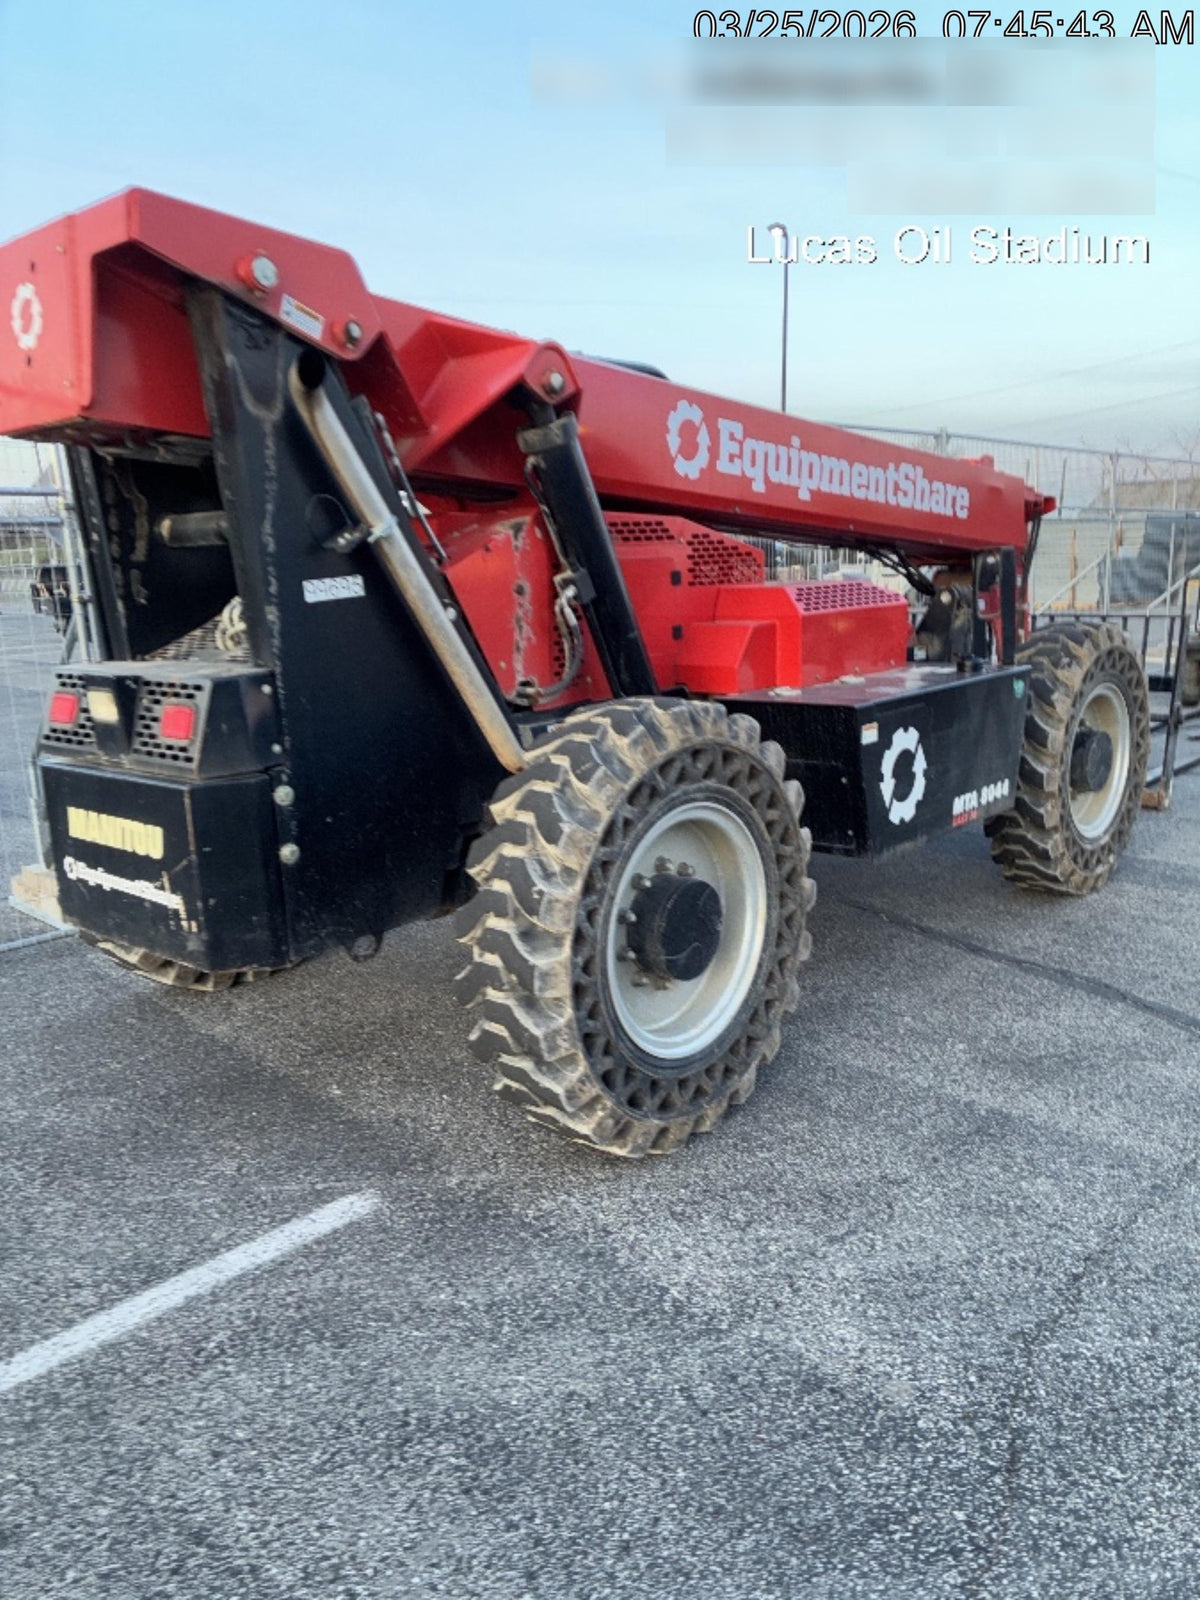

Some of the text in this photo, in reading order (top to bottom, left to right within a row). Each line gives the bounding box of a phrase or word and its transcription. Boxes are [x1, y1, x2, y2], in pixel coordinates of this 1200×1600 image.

[716, 417, 970, 520] EquipmentShare
[952, 778, 1009, 816] MTA 8044
[66, 805, 165, 860] MANITOU
